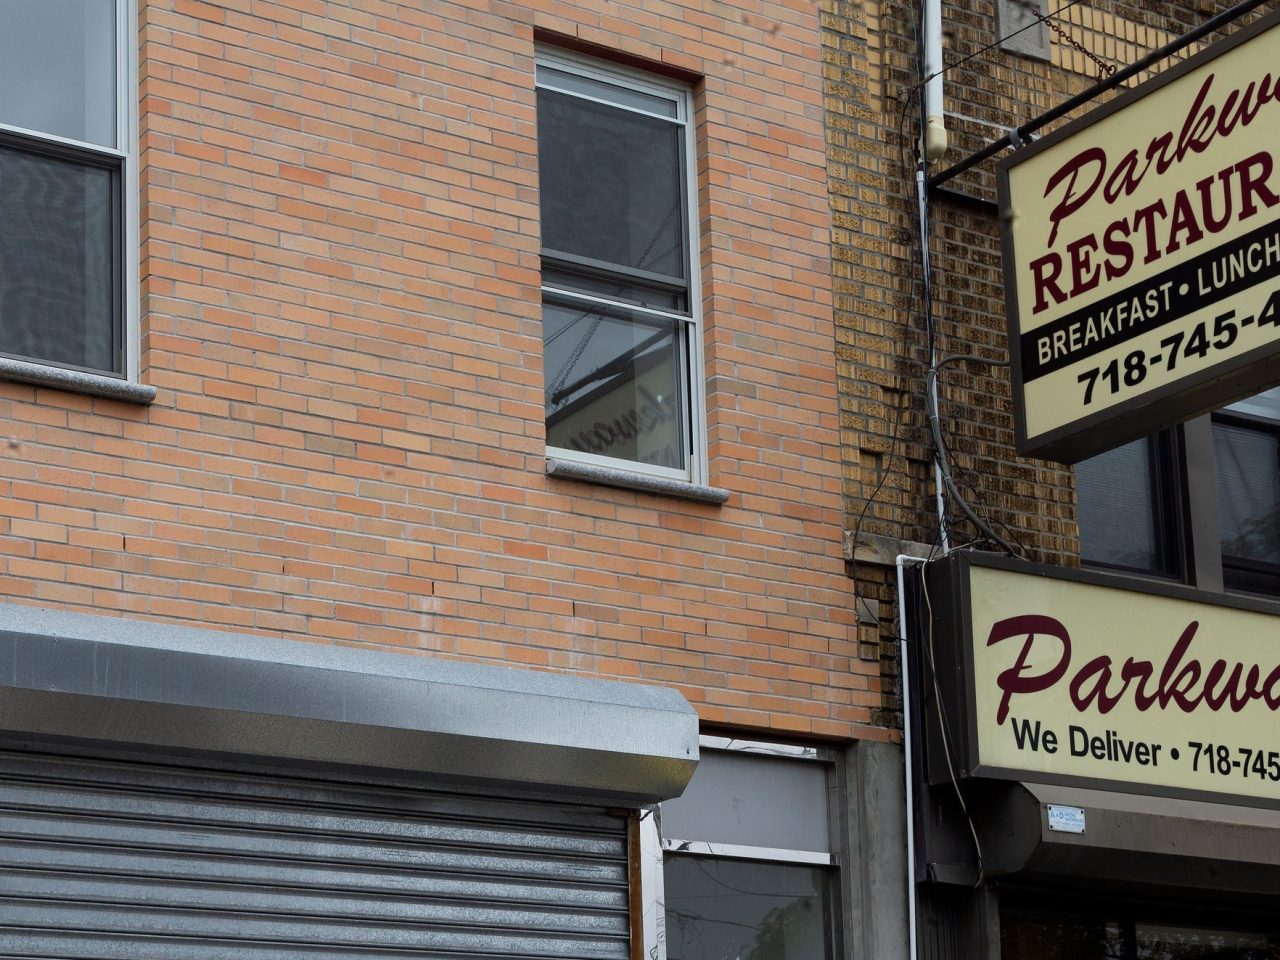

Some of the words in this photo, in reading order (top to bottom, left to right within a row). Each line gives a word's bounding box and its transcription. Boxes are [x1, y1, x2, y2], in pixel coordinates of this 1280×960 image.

[1029, 150, 1280, 315] RESTAUR
[1044, 72, 1280, 248] Parkw
[1037, 281, 1173, 366] BREAKFAST
[1197, 232, 1280, 297] LUNCH
[1010, 717, 1058, 754] We
[1069, 724, 1162, 766] Deliver
[1188, 741, 1280, 782] 718-745
